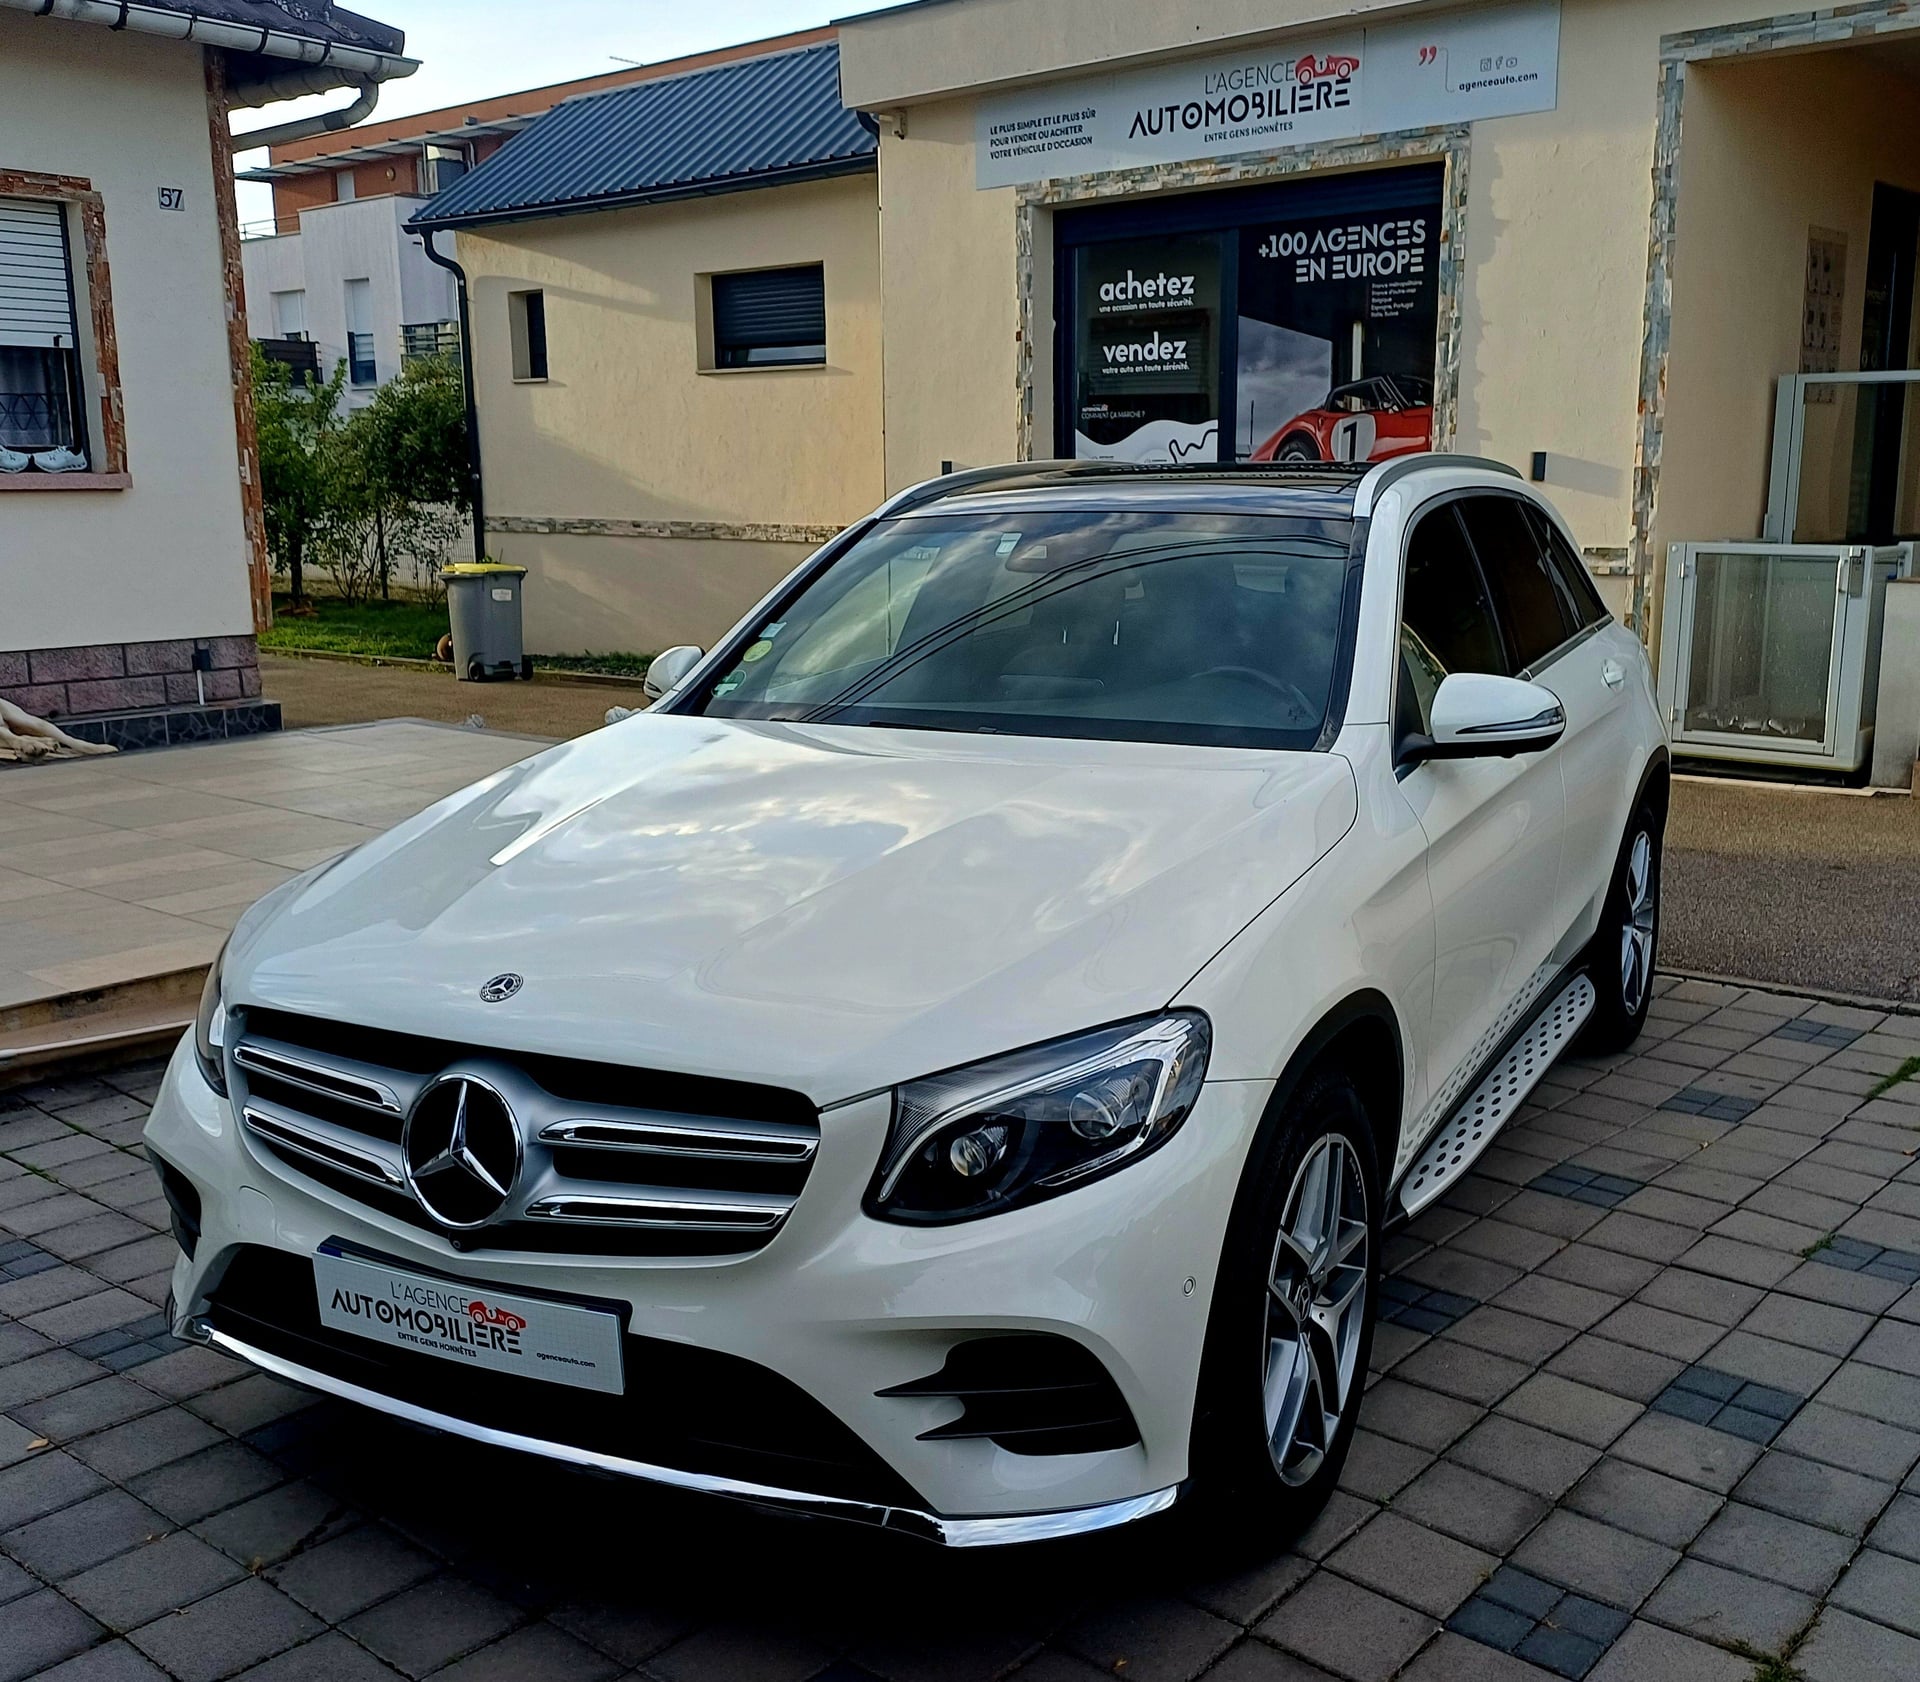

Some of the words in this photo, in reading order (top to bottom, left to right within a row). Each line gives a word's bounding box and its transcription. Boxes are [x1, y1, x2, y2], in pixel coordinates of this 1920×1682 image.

[1205, 59, 1296, 95] L'AGENCE
[1459, 72, 1538, 92] agenceauto.com
[990, 126, 998, 135] LE
[999, 123, 1016, 133] PLUS
[1017, 118, 1042, 131] SIMPLE
[1043, 116, 1052, 126] ET
[1052, 115, 1061, 125] LE
[1062, 112, 1080, 123] PLUS
[1204, 131, 1228, 143] ENTRE
[1229, 127, 1250, 139] GENS
[1251, 121, 1294, 136] HONNÊTES
[990, 137, 1009, 148] POUR
[1010, 131, 1037, 144] VENDRE
[1039, 130, 1049, 140] OU
[1050, 124, 1083, 138] ACHETER
[990, 148, 1012, 160] VOTRE
[1013, 143, 1046, 157] VÉHICULE
[160, 187, 183, 208] 57
[1258, 231, 1308, 258] +100
[1310, 219, 1426, 254] AGENCES
[1296, 257, 1326, 283] EN
[1332, 247, 1424, 280] EUROPE
[1100, 269, 1194, 301] achetez
[1112, 302, 1138, 312] occasion
[1148, 301, 1165, 309] toute
[1102, 331, 1187, 363] vendez
[1102, 366, 1118, 374] votre
[1120, 366, 1134, 374] auto
[1144, 364, 1161, 372] toute
[1343, 421, 1358, 461] 1
[390, 1281, 470, 1316] L'AGENCE
[398, 1331, 419, 1344] ENTRE
[420, 1337, 438, 1348] GENS
[439, 1342, 477, 1357] HONNÊTES
[537, 1352, 596, 1368] agenceauto.com
